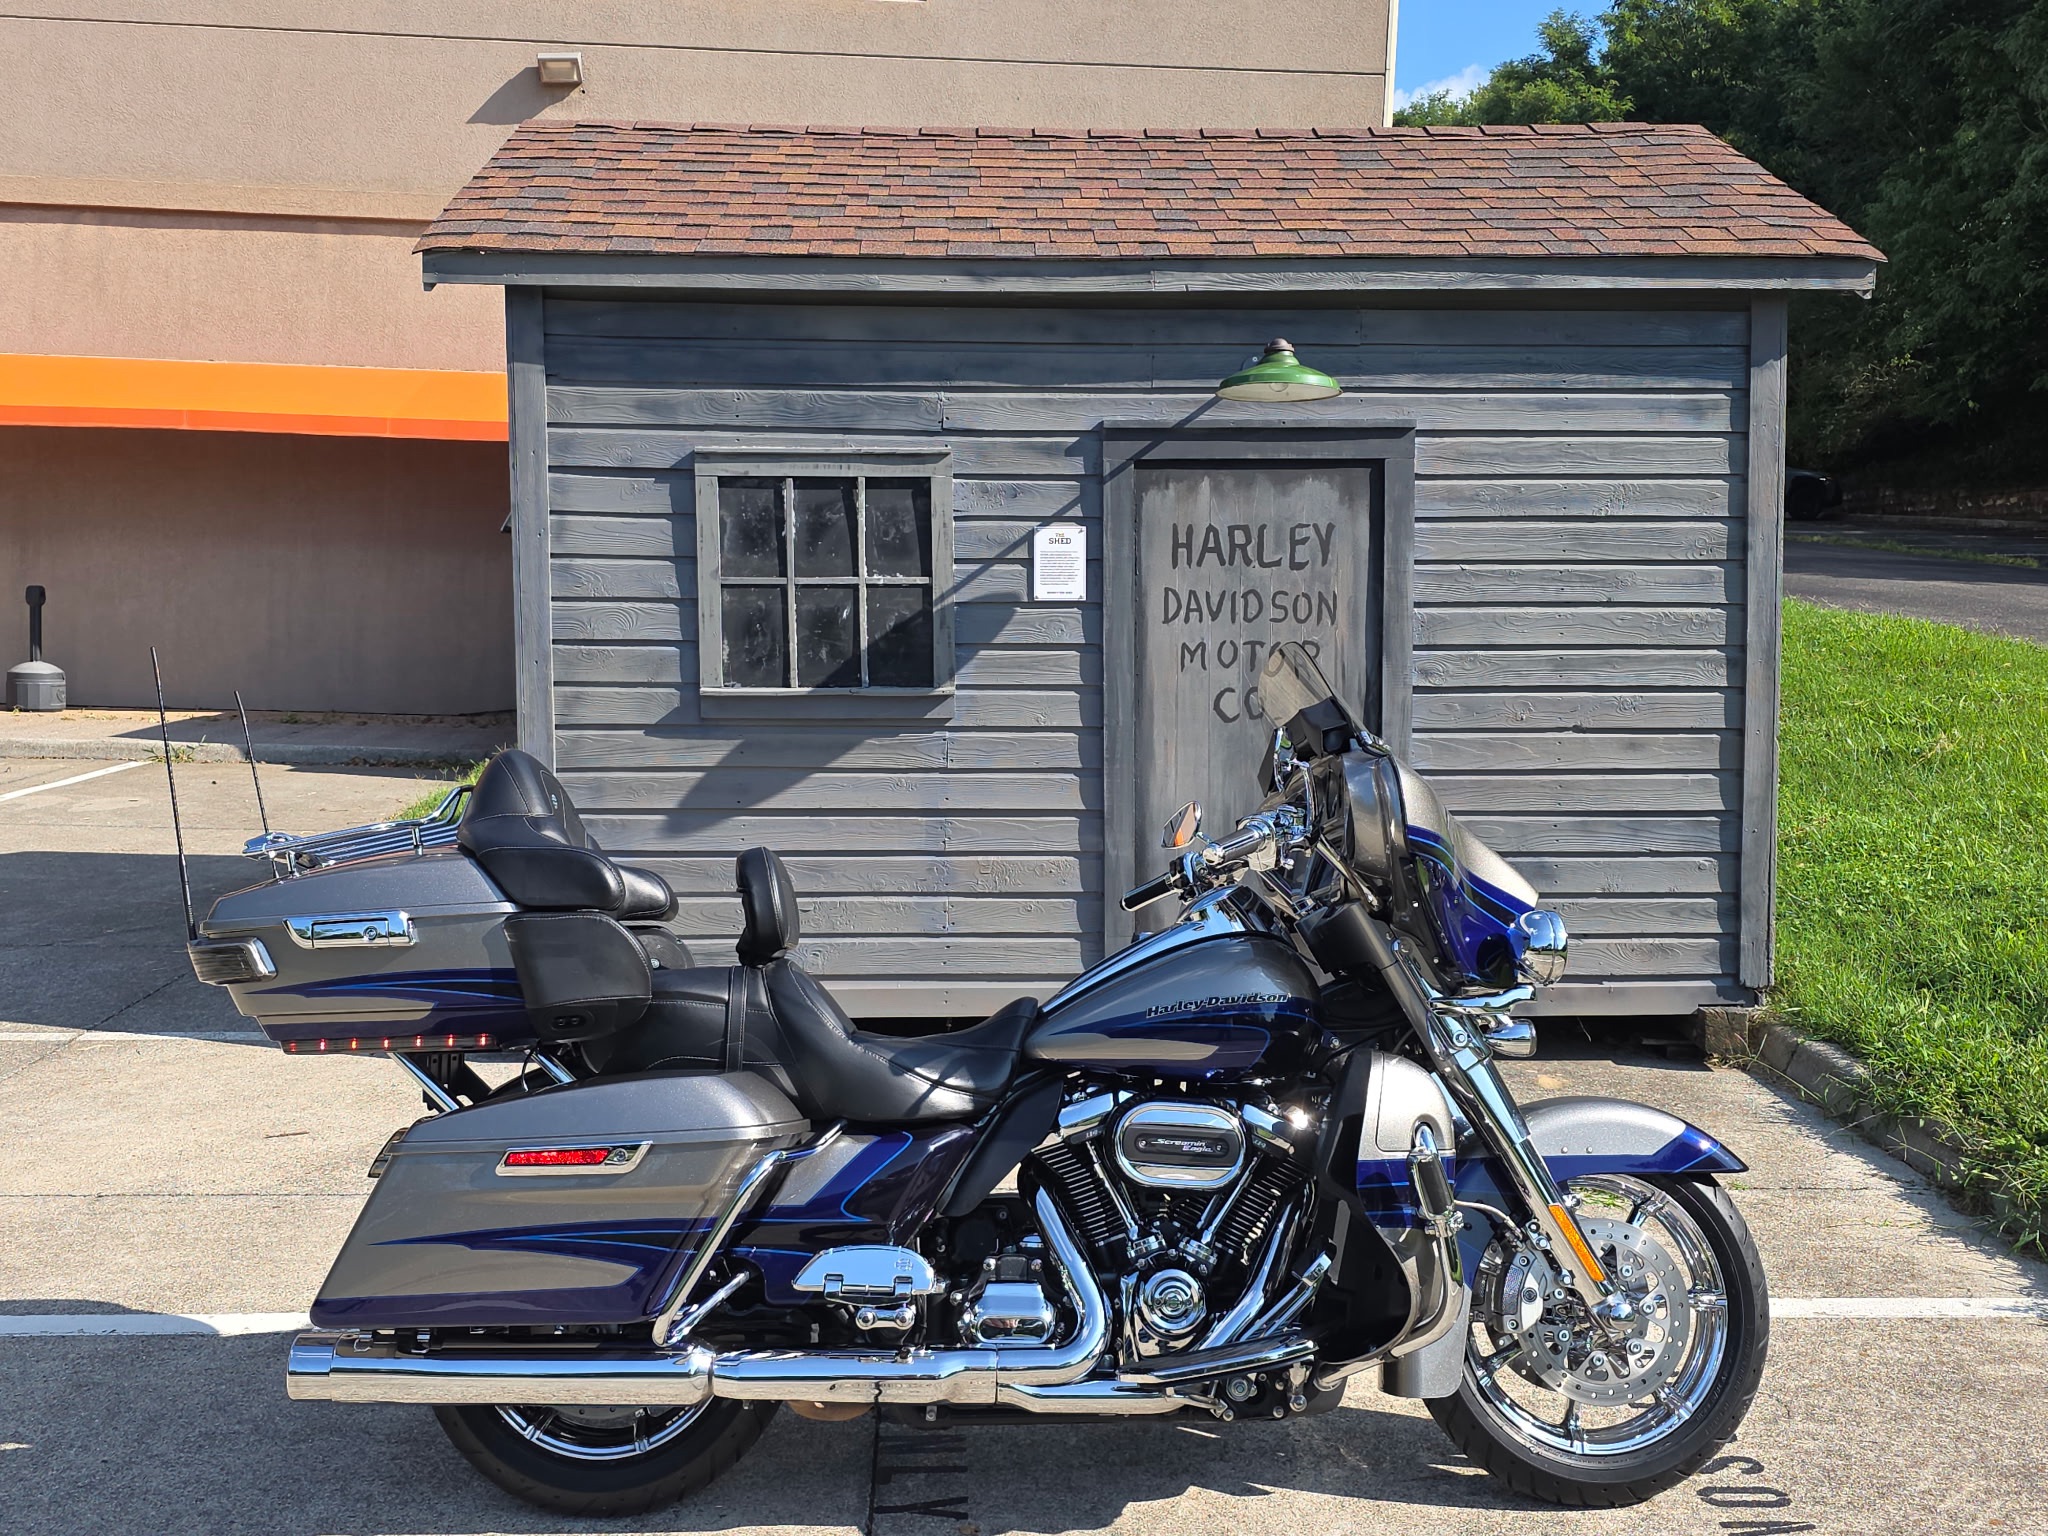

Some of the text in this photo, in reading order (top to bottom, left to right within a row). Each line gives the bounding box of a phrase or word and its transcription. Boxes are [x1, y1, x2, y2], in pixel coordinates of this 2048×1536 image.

[1048, 537, 1072, 545] SHED
[1172, 521, 1336, 570] HARLEY
[1162, 586, 1338, 626] DAVIDSON
[1146, 992, 1290, 1018] Harley-Davidson
